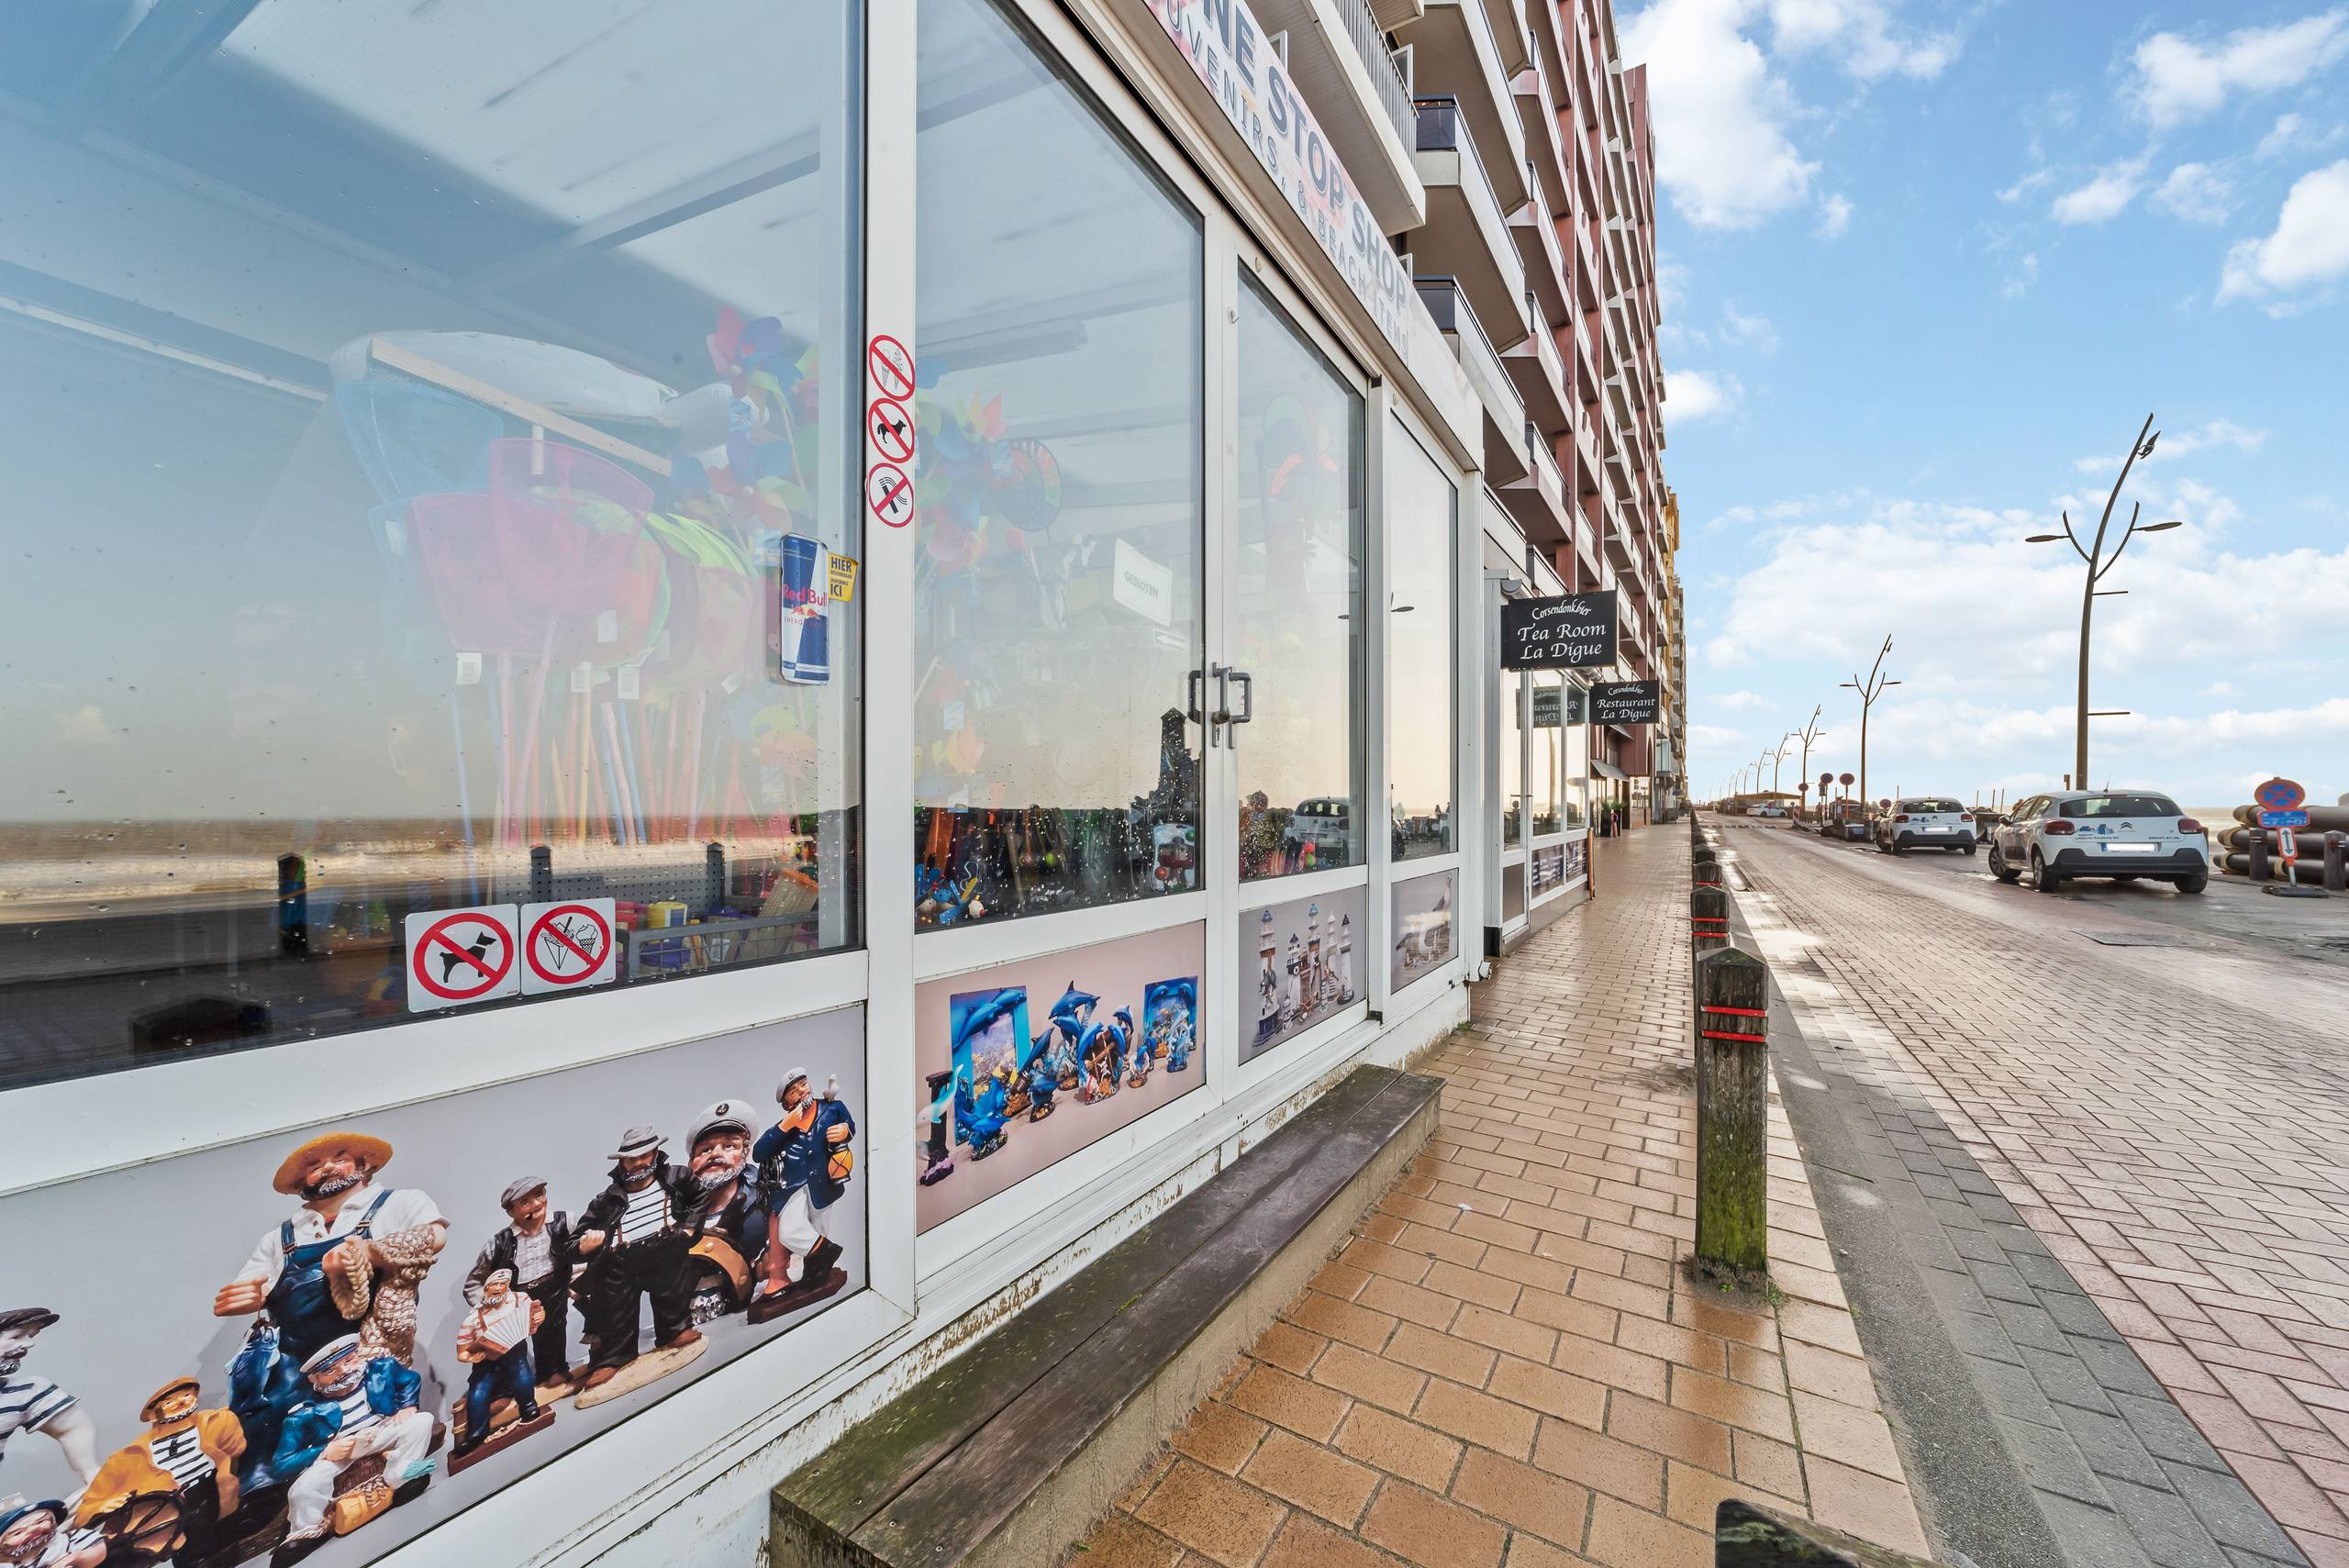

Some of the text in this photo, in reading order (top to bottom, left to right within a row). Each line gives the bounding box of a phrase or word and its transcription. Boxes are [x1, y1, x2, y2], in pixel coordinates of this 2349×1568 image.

[1268, 65, 1343, 209] STOP
[1353, 200, 1406, 311] SHOP
[1298, 179, 1307, 209] &
[1319, 208, 1366, 299] BEACH
[1374, 290, 1408, 360] ITEMS
[830, 556, 852, 573] HIER
[783, 584, 828, 606] Red Bull
[830, 584, 842, 596] ICI
[1124, 571, 1159, 598] GESLOTEN
[1531, 598, 1592, 620] Corsendonkbier
[1517, 622, 1607, 641] Tea Room
[1520, 641, 1602, 663] La Digue
[1597, 698, 1656, 708] Restaurant
[1600, 708, 1652, 722] La Digue
